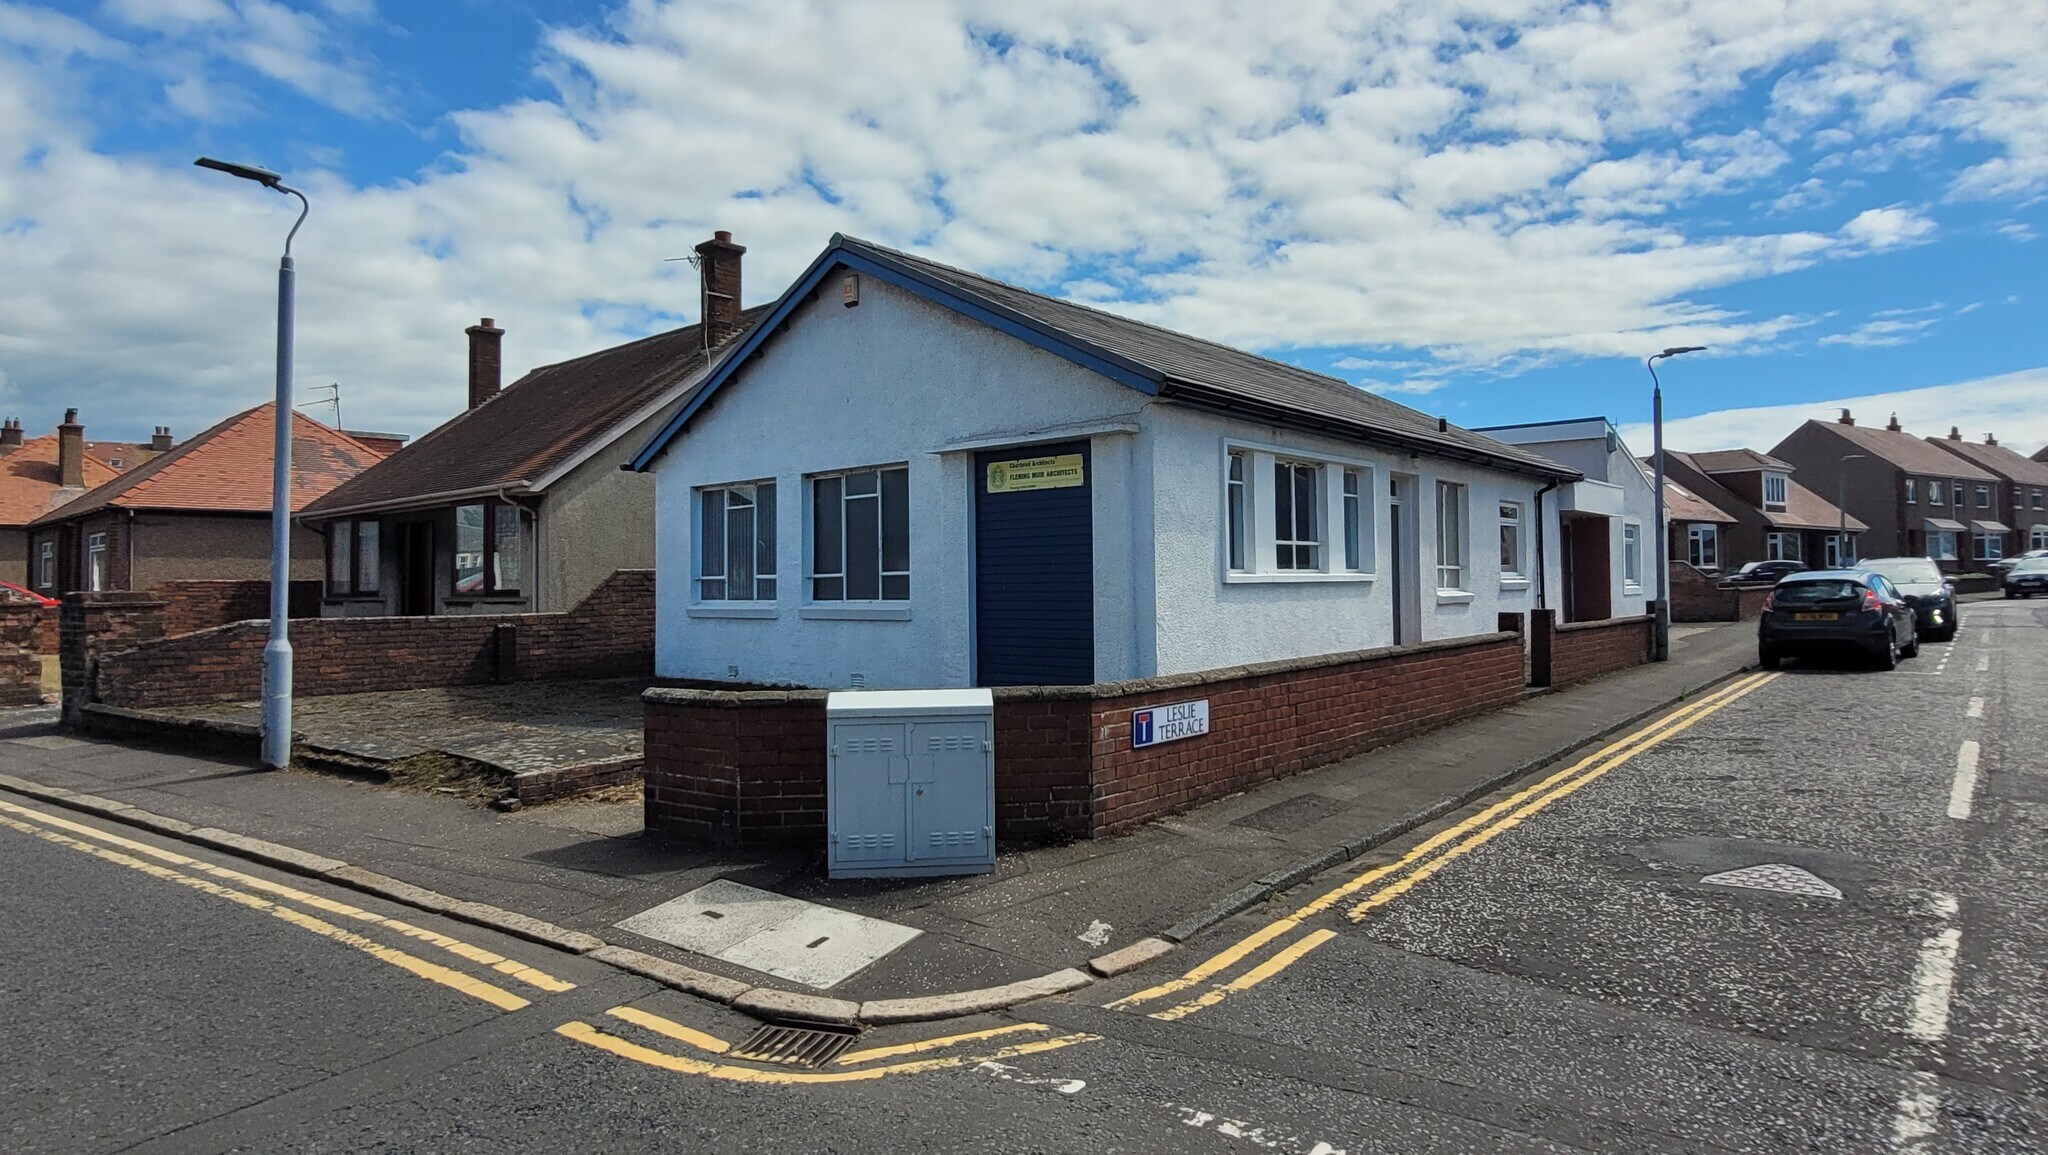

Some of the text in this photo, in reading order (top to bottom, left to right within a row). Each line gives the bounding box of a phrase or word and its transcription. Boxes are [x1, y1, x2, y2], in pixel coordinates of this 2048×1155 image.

[1032, 459, 1055, 467] Architects
[1032, 471, 1044, 479] MUIR
[1046, 468, 1078, 477] ARCHITECTS
[1166, 704, 1196, 722] LESLIE
[1158, 718, 1204, 740] TERRACE
